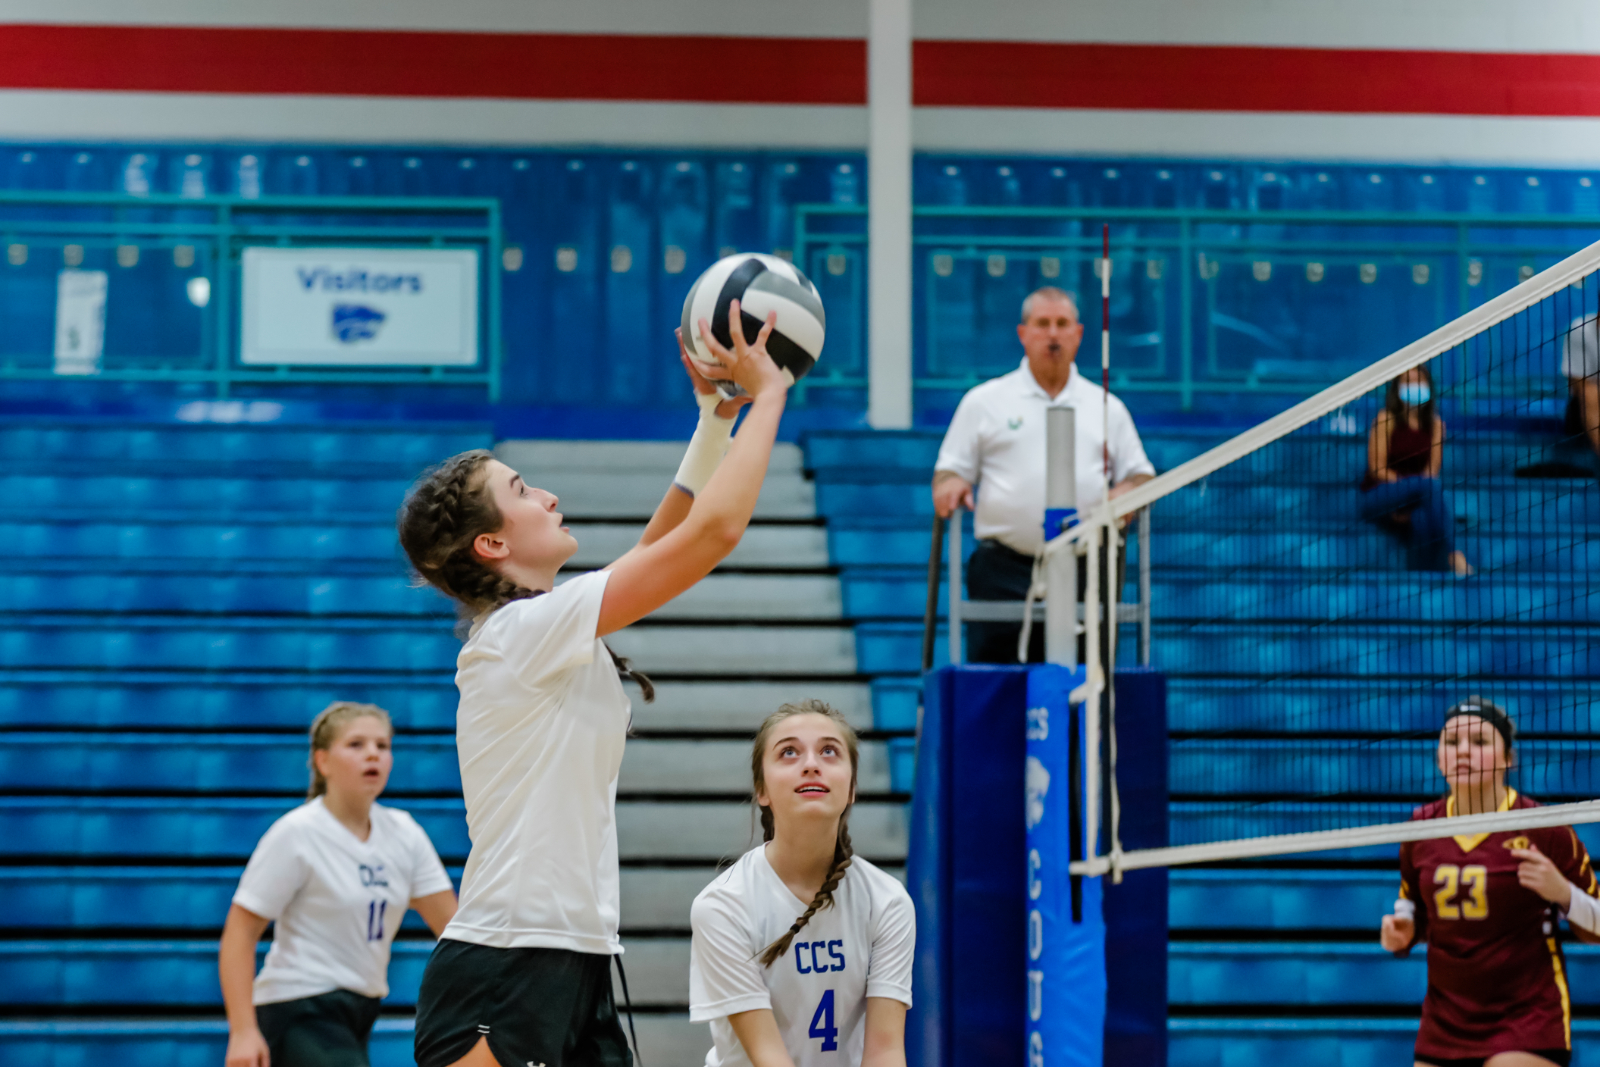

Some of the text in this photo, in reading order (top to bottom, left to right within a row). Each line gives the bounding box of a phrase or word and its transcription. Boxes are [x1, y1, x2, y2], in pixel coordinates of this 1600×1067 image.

[297, 266, 421, 294] Visitors
[1434, 864, 1488, 919] 23
[368, 899, 387, 941] 11
[795, 939, 846, 974] CCS
[808, 989, 838, 1052] 4
